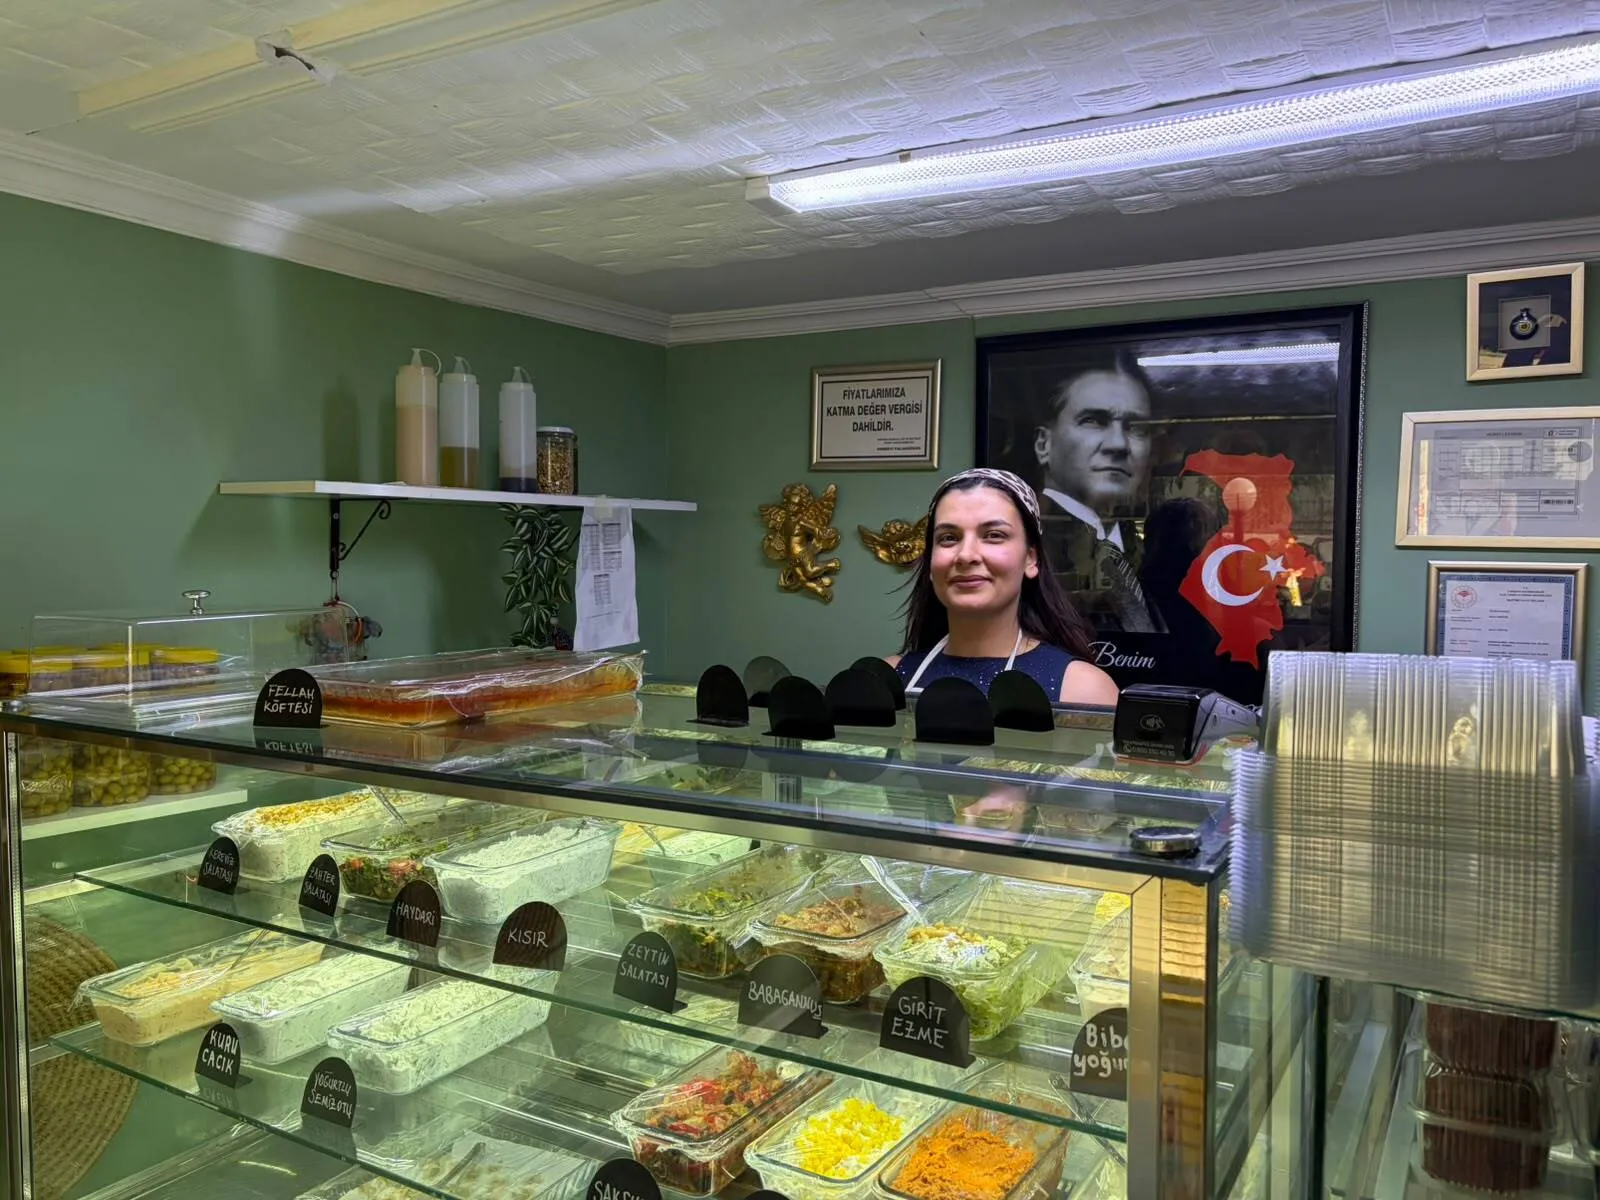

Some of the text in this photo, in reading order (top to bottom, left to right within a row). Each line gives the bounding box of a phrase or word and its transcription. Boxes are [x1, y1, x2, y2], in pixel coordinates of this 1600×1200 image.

[843, 386, 906, 400] FİYATLARIMIZA
[826, 400, 922, 417] KATMA DEĞER VERGİSİ
[852, 418, 894, 432] DAHİLDİR.
[1088, 641, 1156, 669] Benim
[268, 684, 315, 700] FELLAH
[263, 699, 313, 714] KÖFTESİ
[203, 862, 234, 884] SALATASI
[309, 866, 336, 886] ZAHTER
[507, 928, 549, 948] KISIR
[627, 943, 670, 966] ZEYTİN
[619, 962, 670, 989] SALATASI
[898, 996, 947, 1025] GİRİT
[210, 1029, 239, 1056] KURU
[891, 1016, 949, 1049] EZME
[202, 1048, 234, 1076] CACIK
